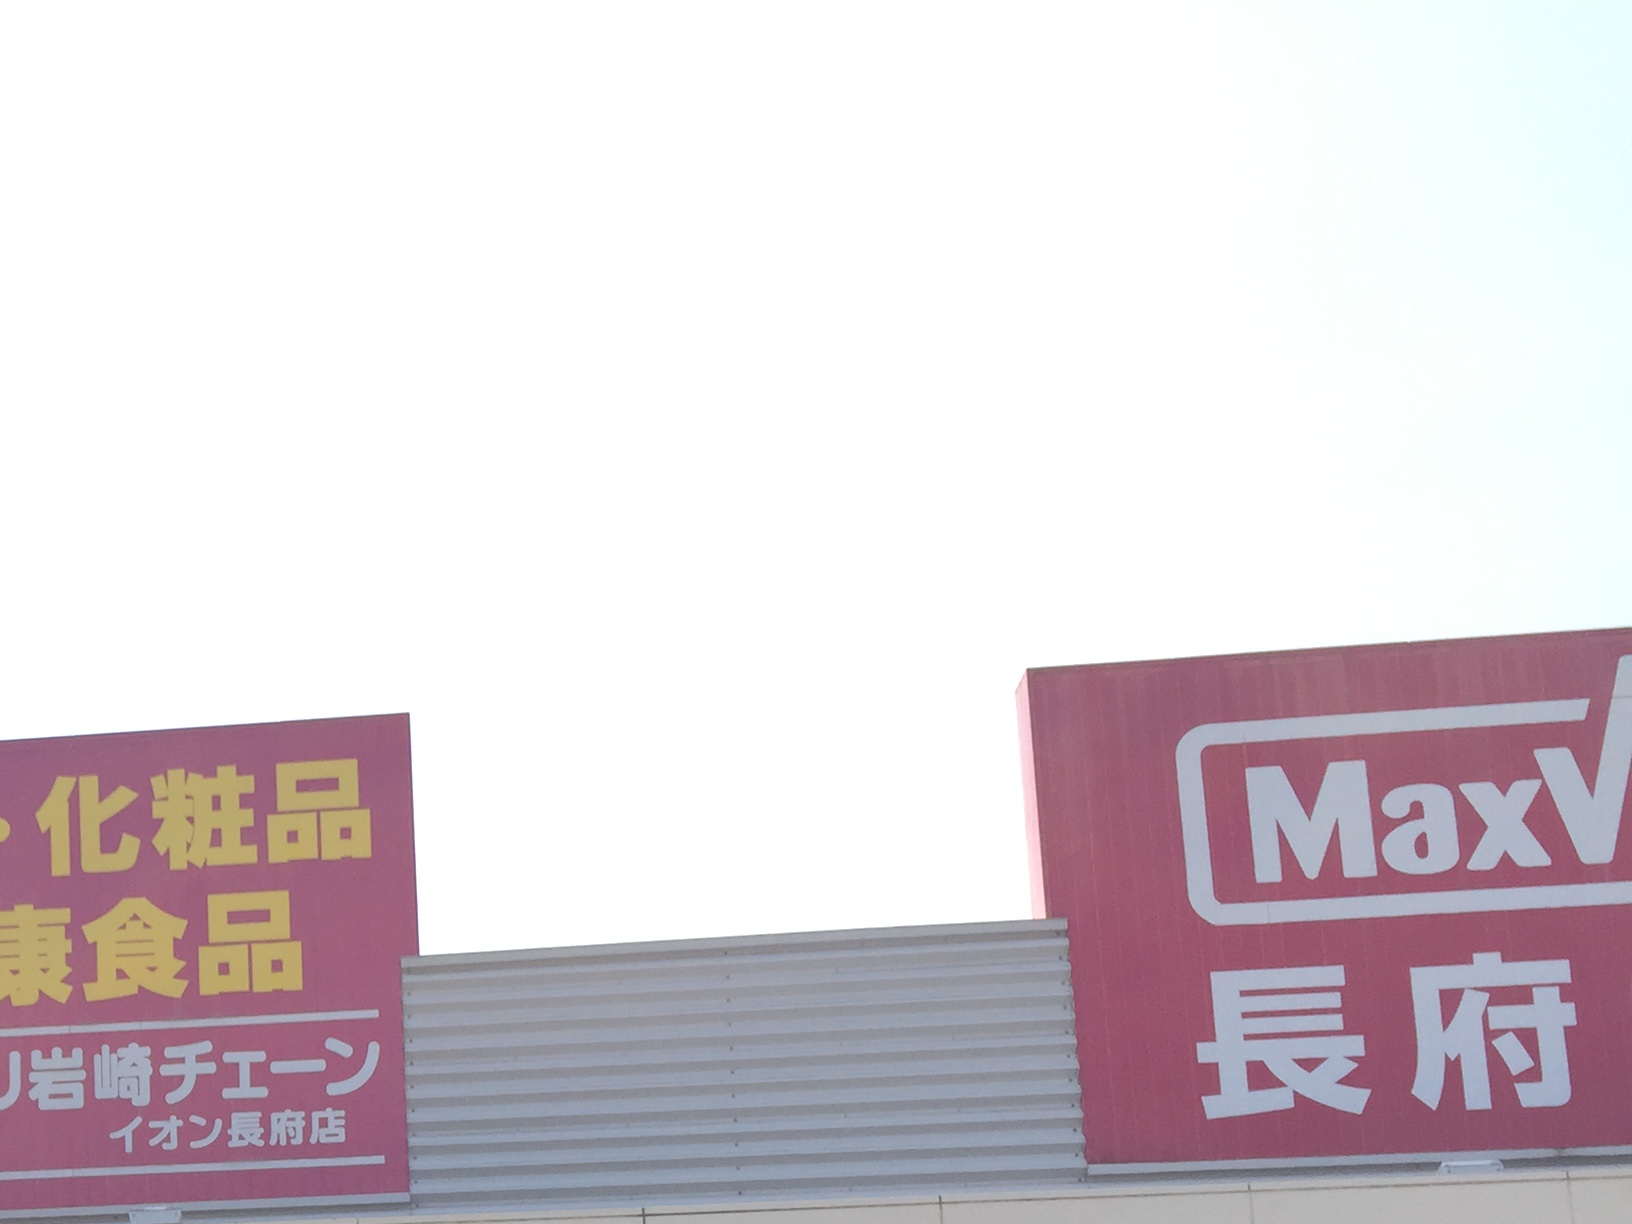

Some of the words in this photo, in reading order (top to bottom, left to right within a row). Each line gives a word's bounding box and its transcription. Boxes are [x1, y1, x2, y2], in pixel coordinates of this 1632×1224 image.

[110, 1107, 347, 1153] イオン長府店
